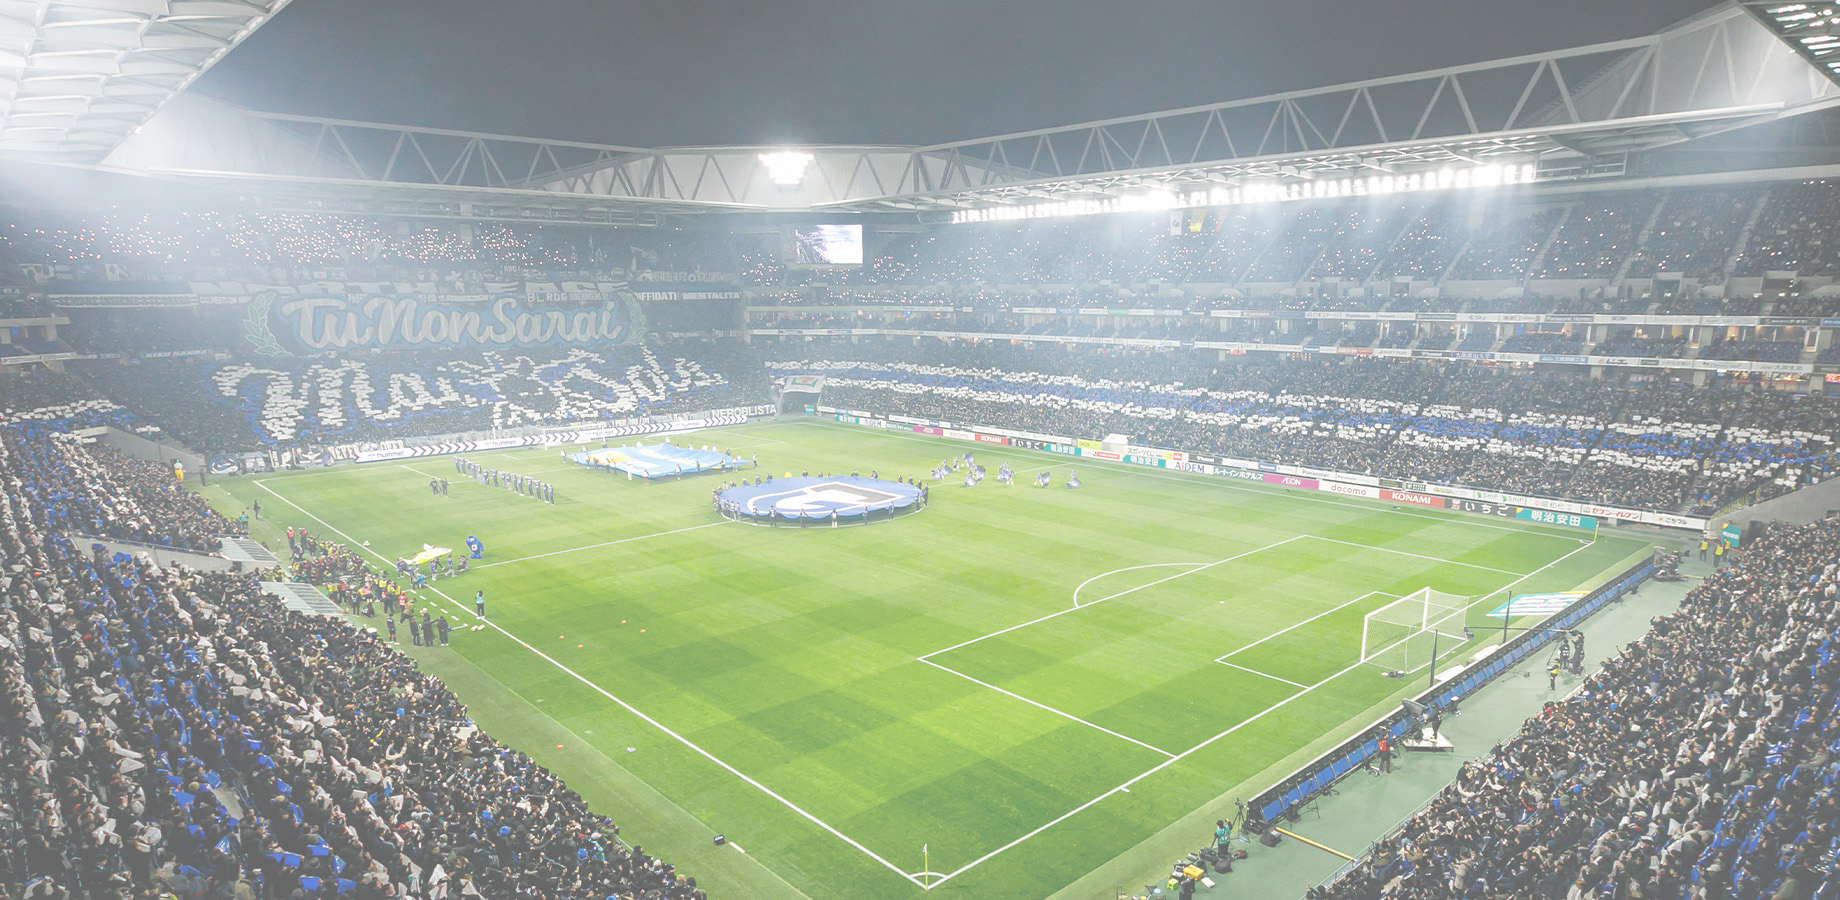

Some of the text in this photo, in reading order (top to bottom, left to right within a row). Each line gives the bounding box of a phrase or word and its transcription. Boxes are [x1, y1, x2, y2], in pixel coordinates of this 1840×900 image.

[486, 296, 625, 344] Sarai
[1302, 469, 1329, 478] Panasonic
[1330, 483, 1367, 496] docomo
[1391, 491, 1431, 505] KONAMI
[1464, 502, 1508, 517] いちご
[1531, 510, 1581, 527] 明治安田
